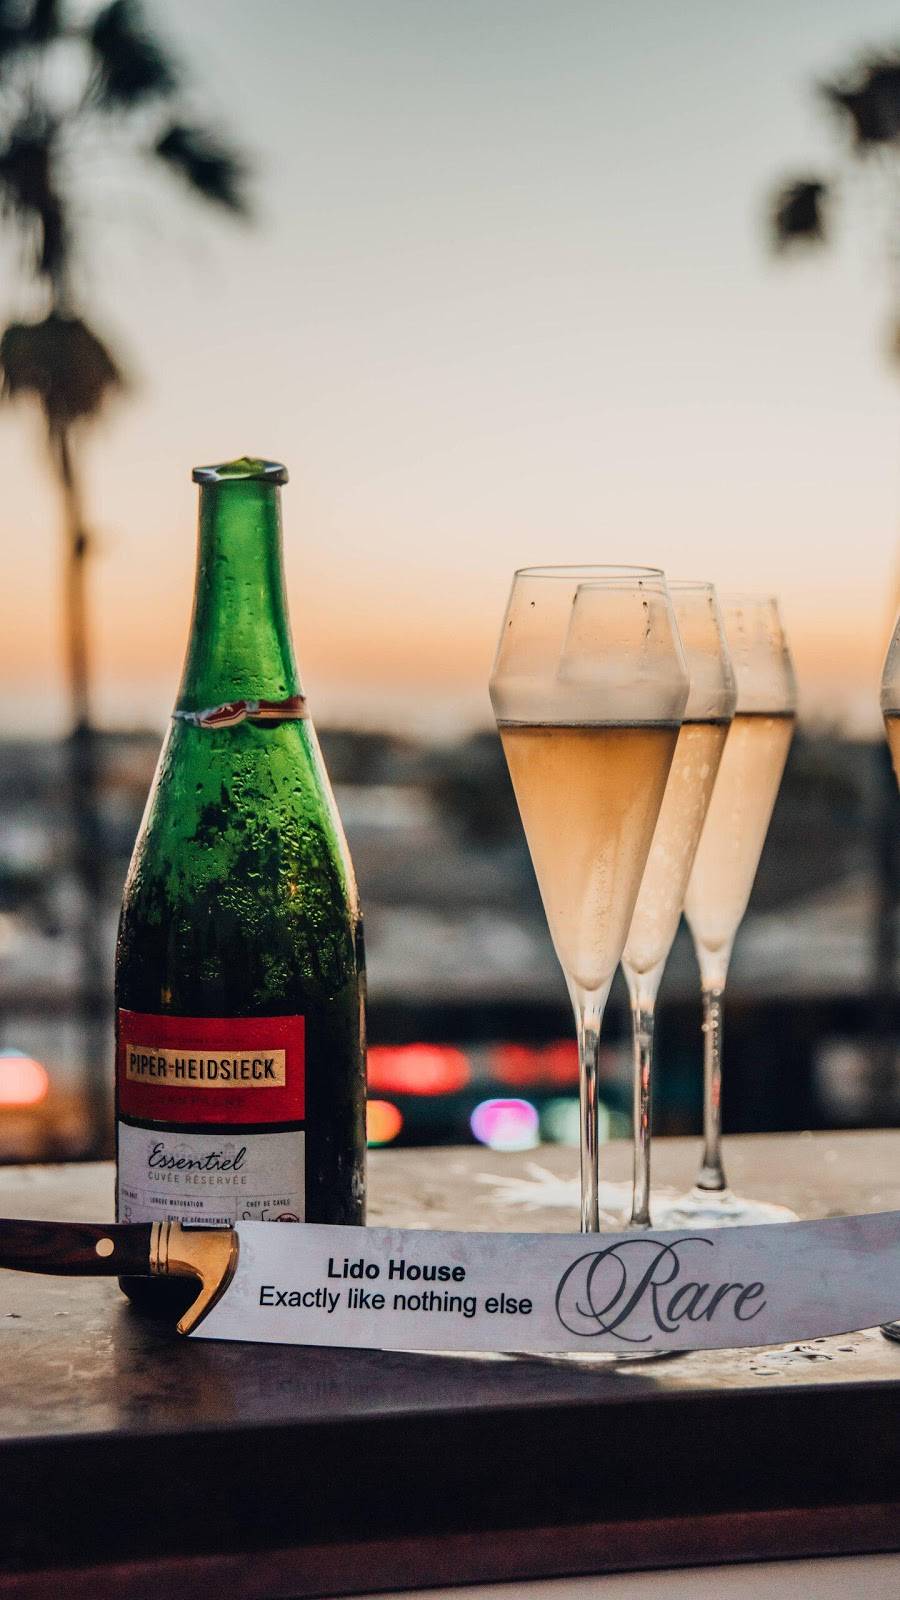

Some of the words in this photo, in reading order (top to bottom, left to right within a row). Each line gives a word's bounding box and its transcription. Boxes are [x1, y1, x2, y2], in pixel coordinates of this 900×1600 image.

[130, 1052, 275, 1081] PIPER-HEIDSIECK
[148, 1142, 247, 1171] Essentiel
[148, 1171, 179, 1183] CUVÉE
[185, 1173, 247, 1185] RÉSERVÉE
[328, 1258, 380, 1279] Lido
[388, 1259, 466, 1282] House
[259, 1286, 341, 1313] Exactly
[348, 1288, 386, 1309] like
[393, 1290, 477, 1318] nothing
[485, 1293, 533, 1314] else
[555, 1237, 766, 1342] Rare
